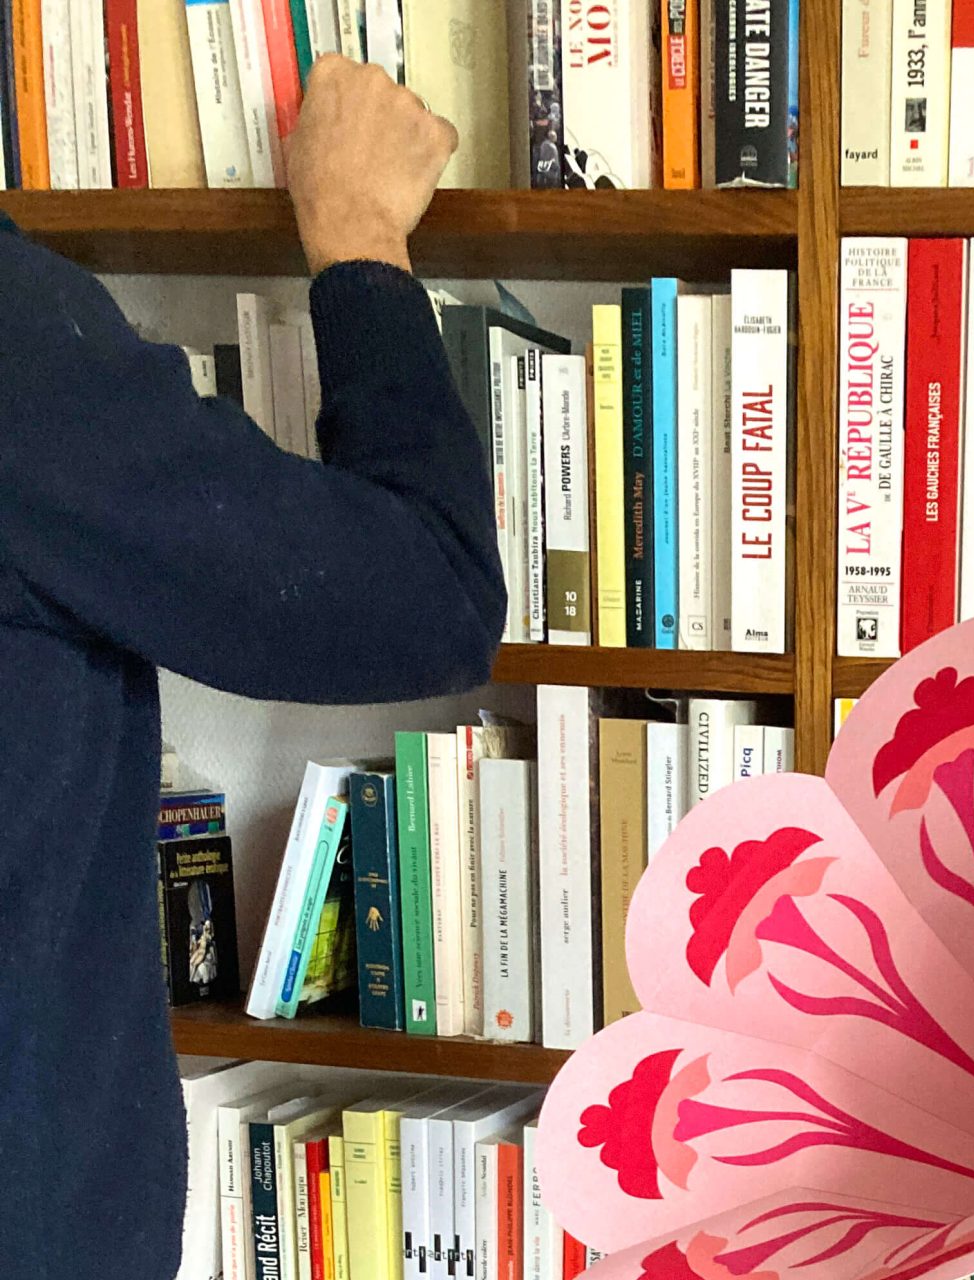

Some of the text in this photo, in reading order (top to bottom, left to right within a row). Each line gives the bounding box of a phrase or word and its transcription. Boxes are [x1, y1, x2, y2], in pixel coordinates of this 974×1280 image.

[745, 42, 770, 128] DANGER
[849, 247, 897, 256] HISTOIRE
[631, 309, 642, 346] MIEL
[842, 301, 879, 481] RÉPUBLIQUE
[879, 355, 894, 490] DE GAULLE À CHIRAC
[561, 444, 571, 492] POWERS
[926, 382, 943, 521] LES GAUCHES FRANÇAISES
[634, 472, 645, 497] May
[742, 384, 772, 559] LE COUP FATAL
[633, 501, 644, 558] Meredith
[846, 516, 871, 555] LA
[845, 566, 891, 576] 1958-1995
[849, 585, 888, 594] ARNAUD
[848, 594, 889, 603] TEYSSIER
[699, 712, 709, 793] CIVILIZED
[740, 748, 753, 777] Picq
[158, 806, 222, 824] CHOPENHAUER
[497, 870, 508, 926] MÉGAMACHINE
[500, 929, 508, 938] LA
[500, 941, 509, 950] DE
[501, 966, 509, 977] LA
[253, 1148, 262, 1182] Johann
[261, 1142, 273, 1191] Chapoutot
[256, 1214, 277, 1251] Récit
